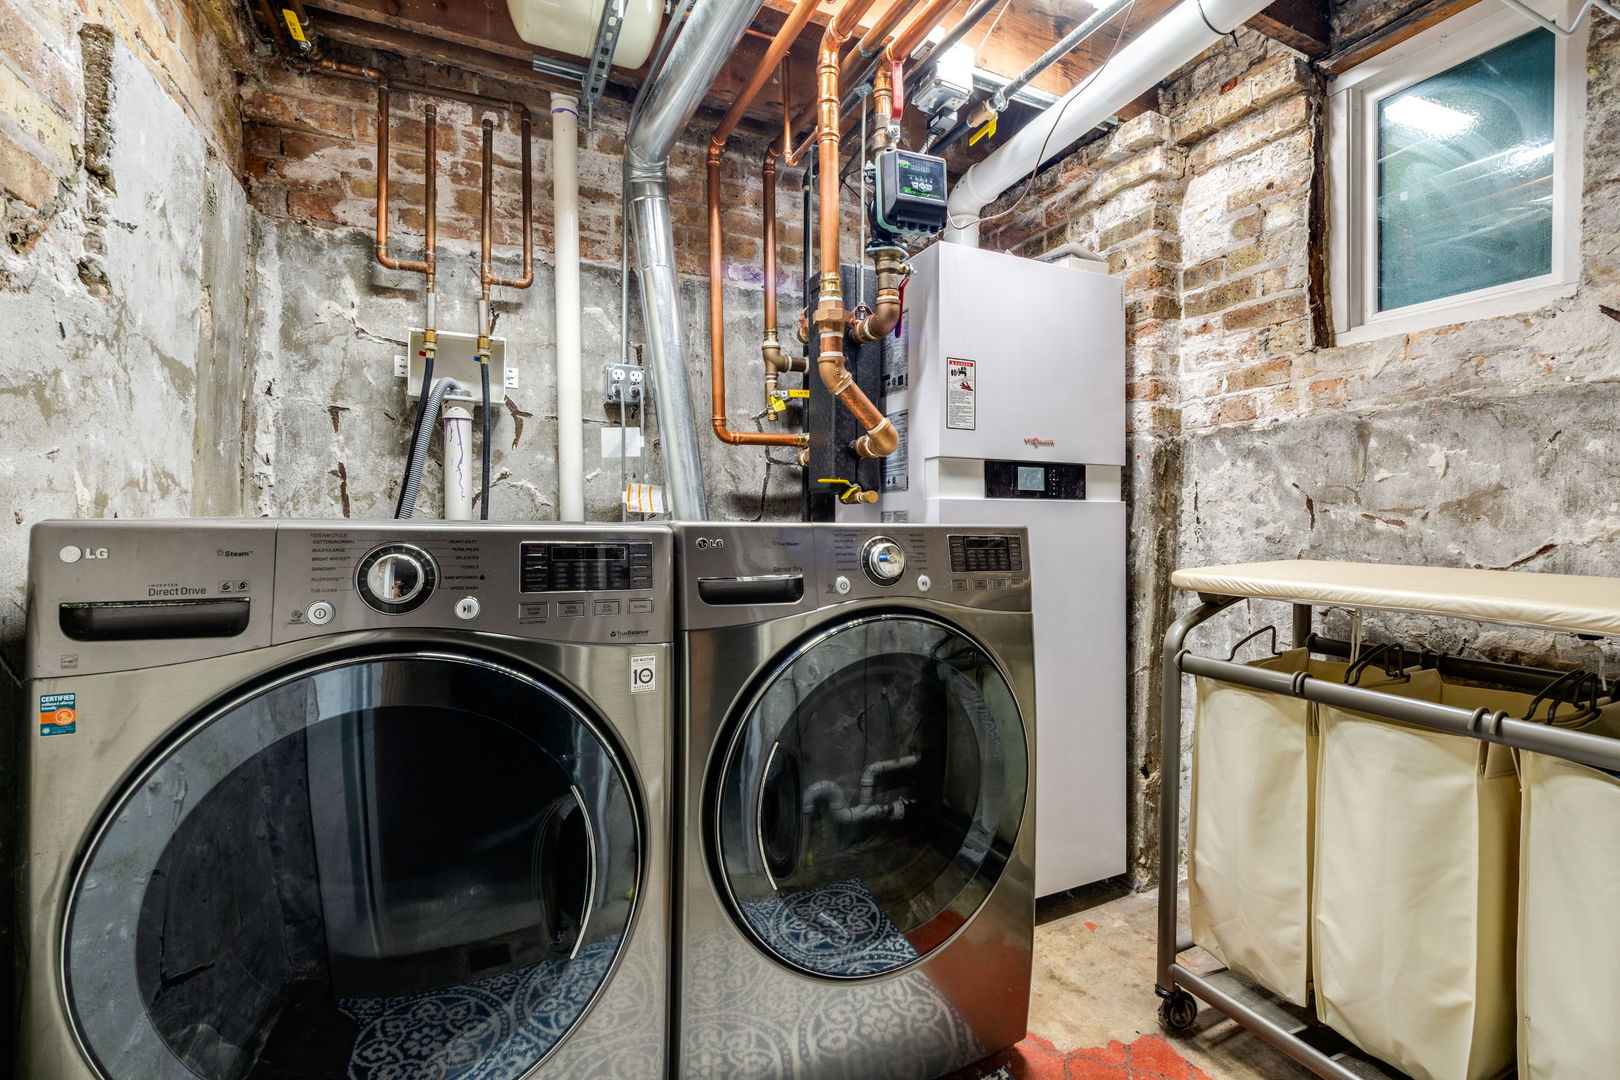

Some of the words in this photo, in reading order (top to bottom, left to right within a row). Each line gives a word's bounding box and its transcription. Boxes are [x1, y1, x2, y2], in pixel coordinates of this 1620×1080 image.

[709, 538, 723, 548] LG
[85, 548, 109, 559] LG
[148, 587, 179, 596] Direct
[180, 586, 207, 595] Drive
[633, 667, 653, 685] 10
[41, 694, 75, 703] CERTIFIED
